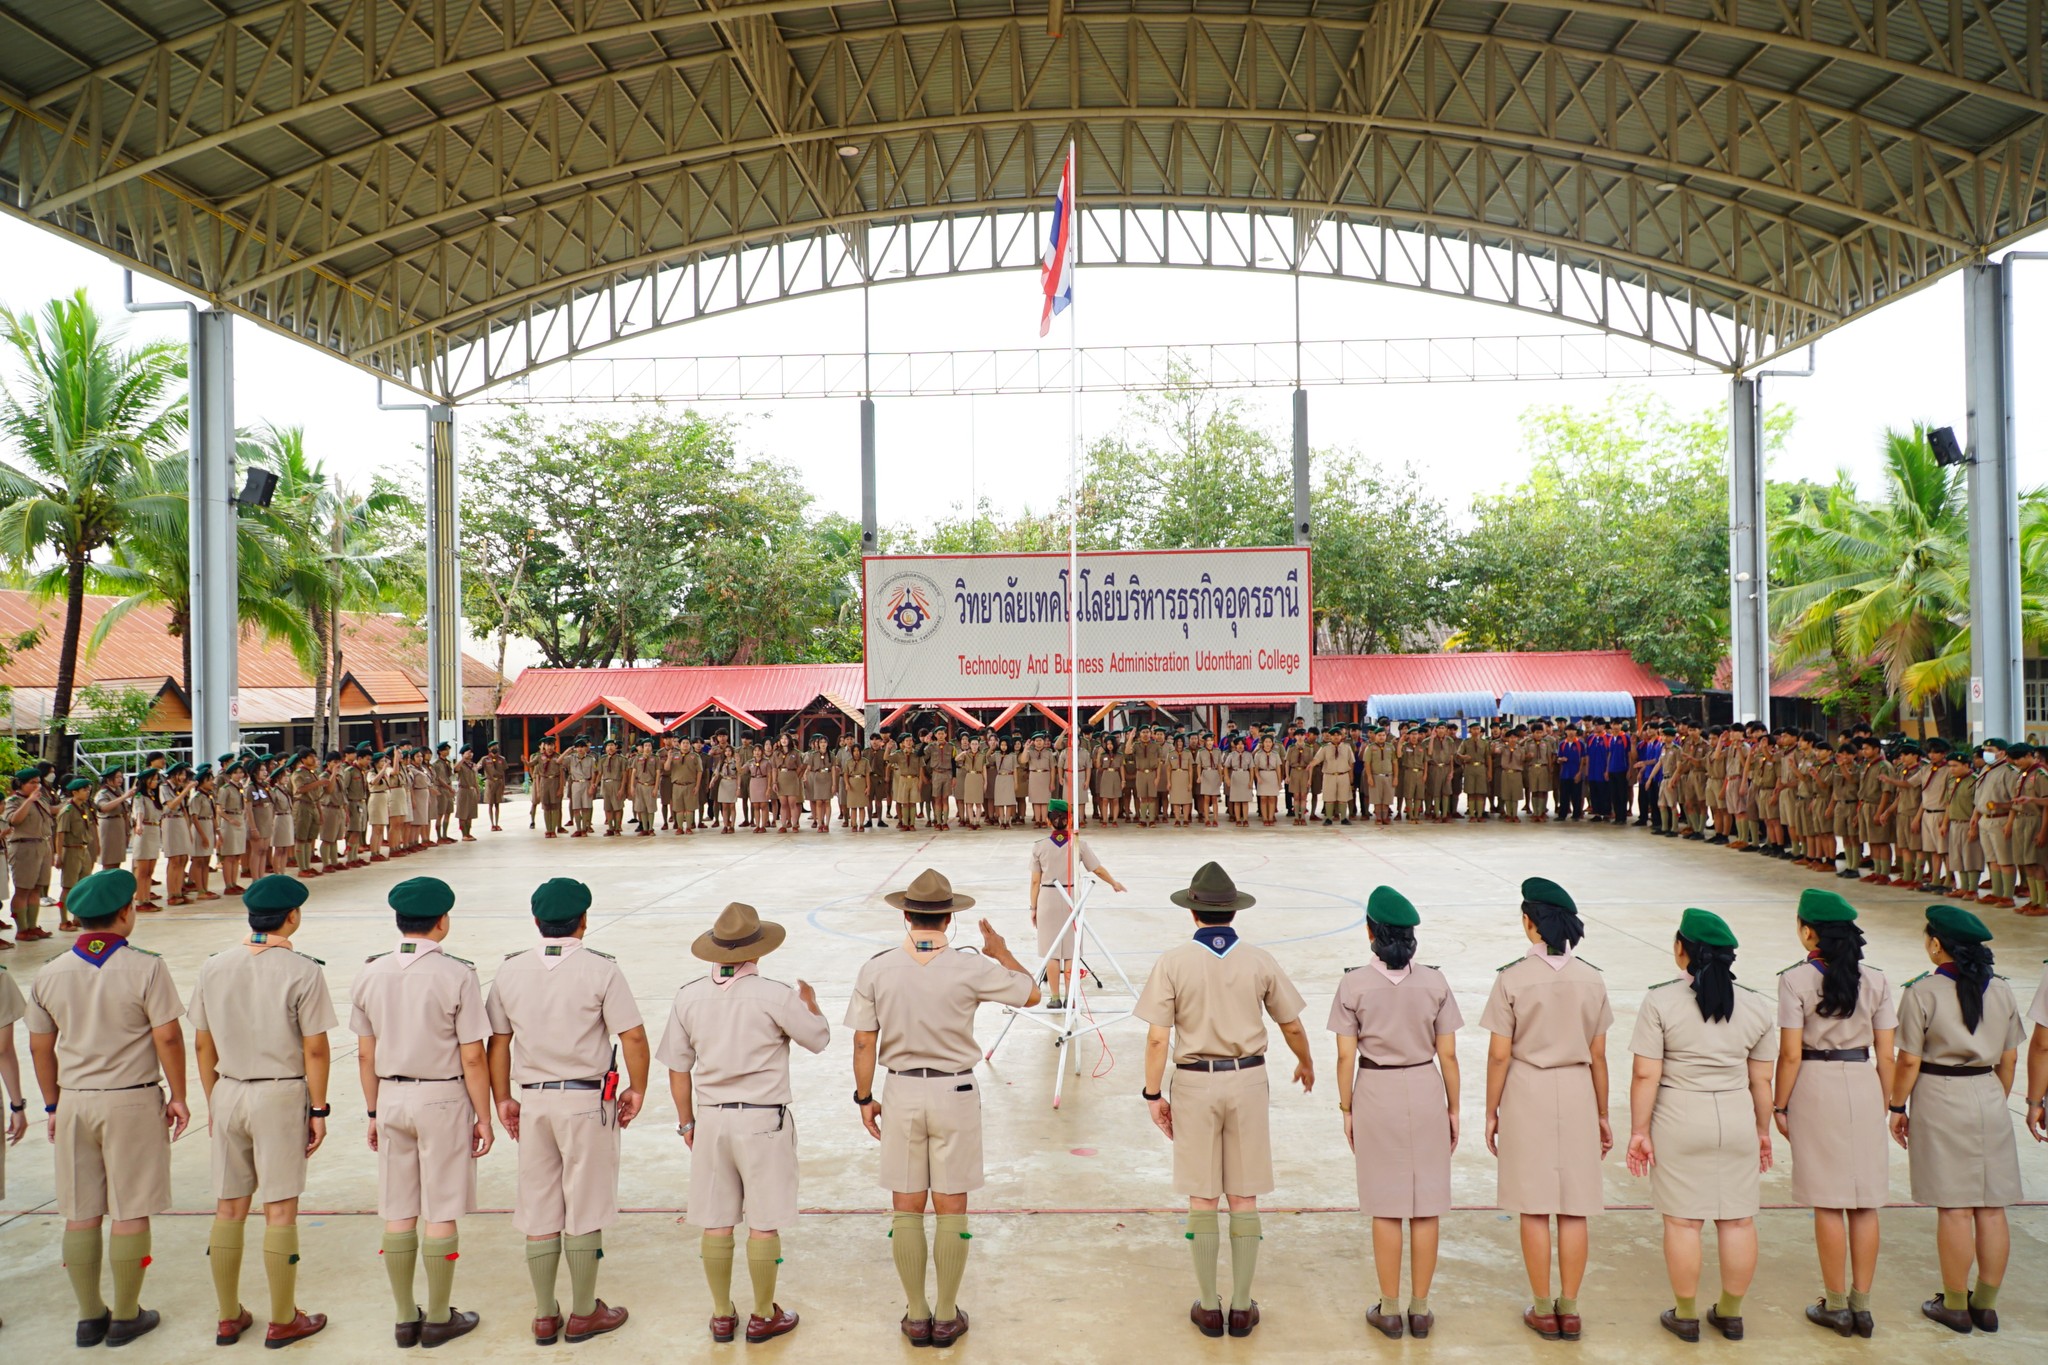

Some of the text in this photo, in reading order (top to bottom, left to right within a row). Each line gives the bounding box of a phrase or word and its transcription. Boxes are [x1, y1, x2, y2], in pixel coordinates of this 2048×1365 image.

[958, 649, 1300, 679] Technology And Busness Administration Udonthani College
